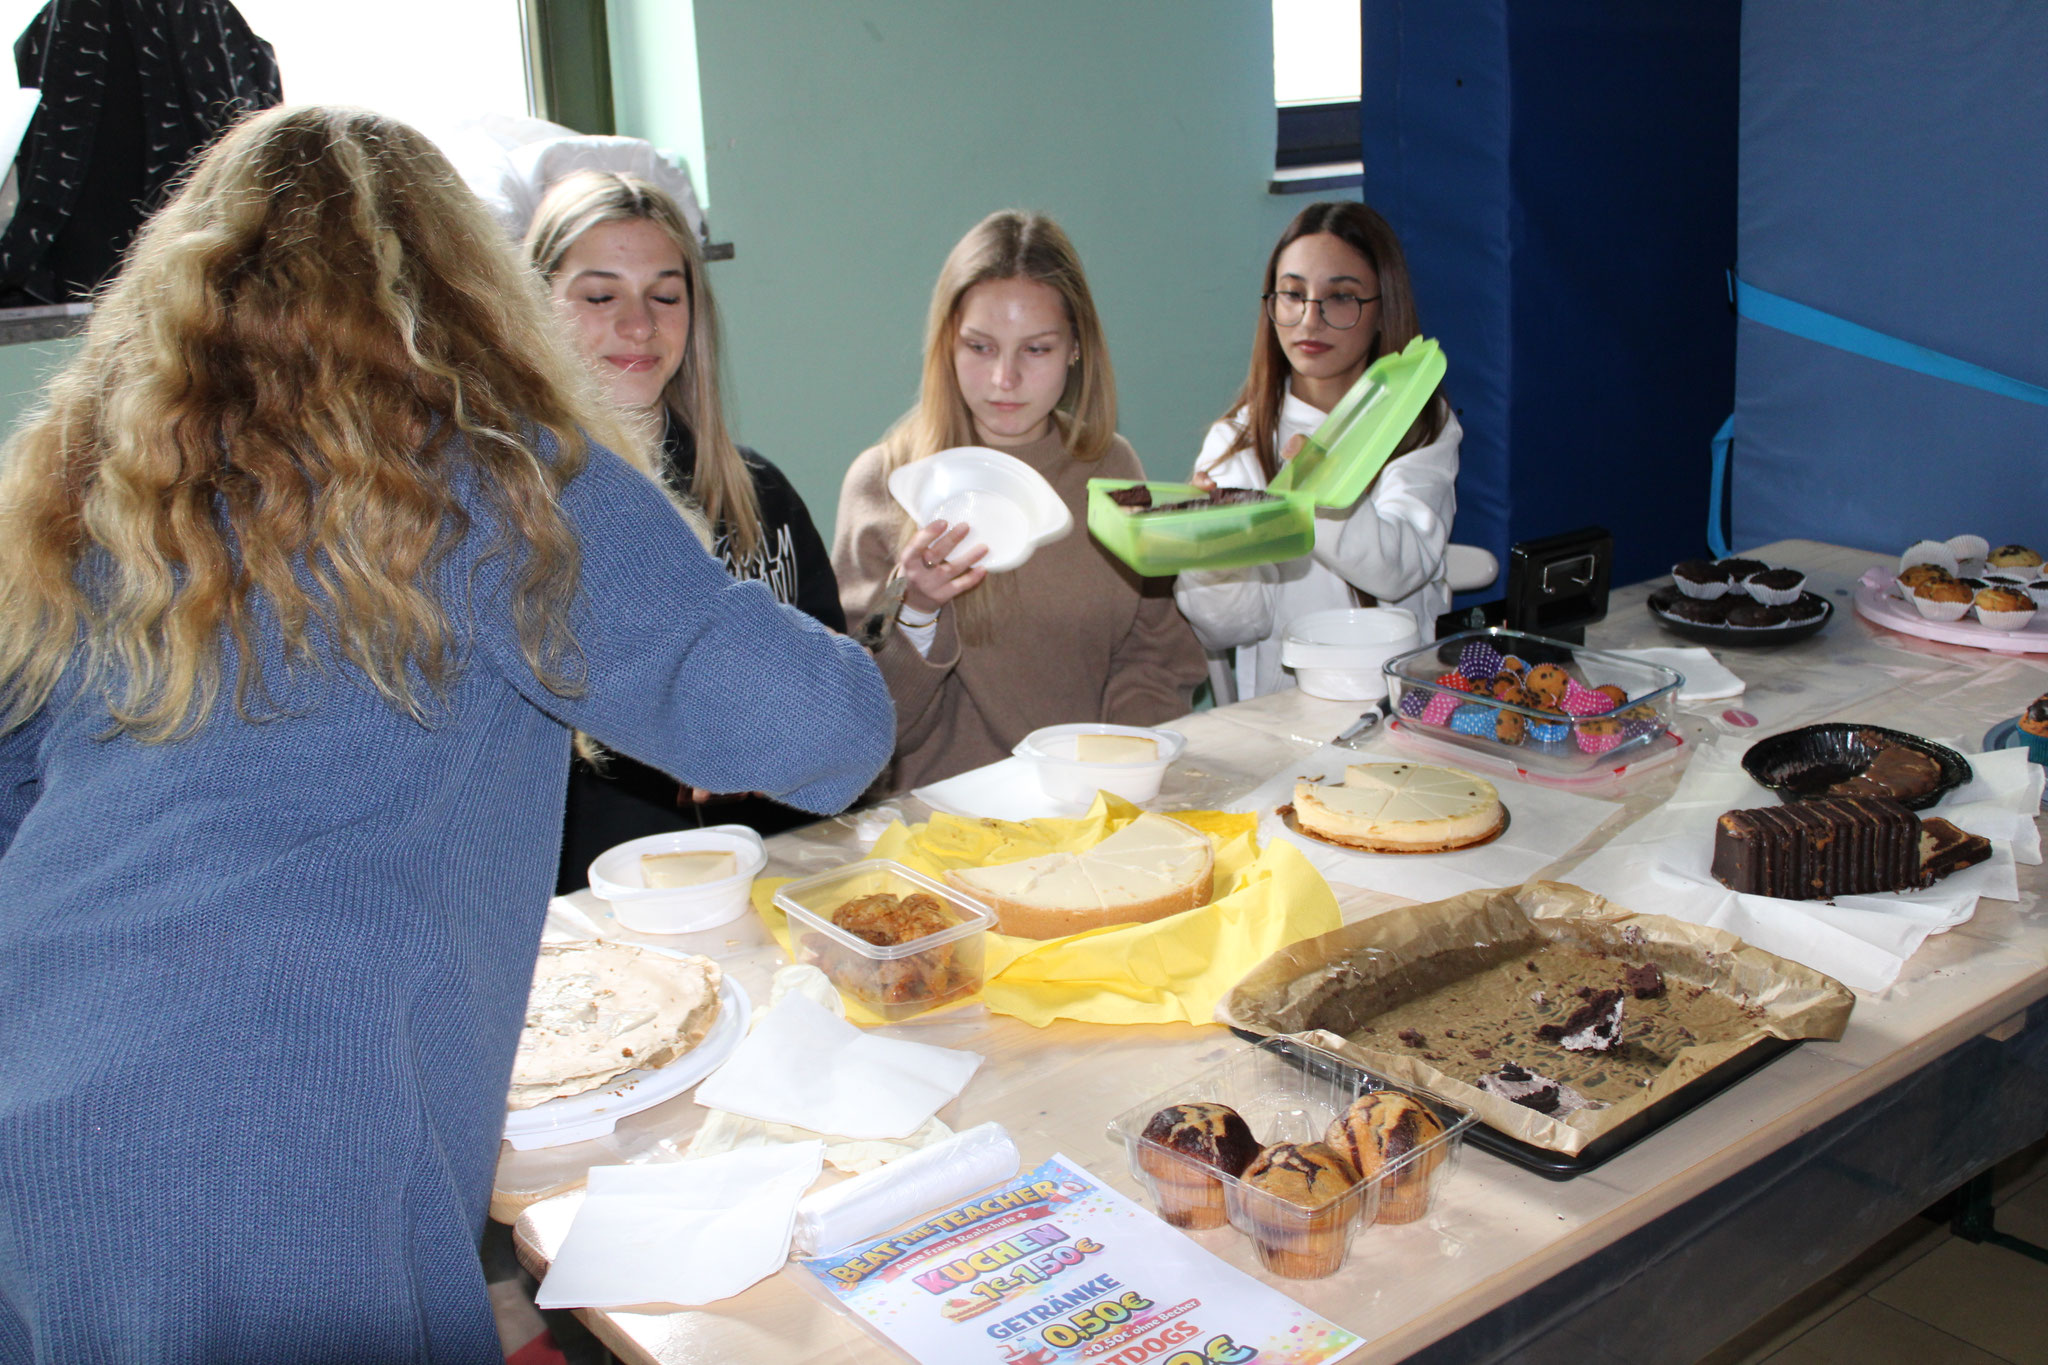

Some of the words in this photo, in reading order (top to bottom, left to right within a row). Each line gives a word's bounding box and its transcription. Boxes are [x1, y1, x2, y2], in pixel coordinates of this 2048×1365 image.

[827, 1240, 907, 1285] BEAT
[892, 1224, 942, 1246] THE
[927, 1180, 1060, 1233] TEACHER
[895, 1255, 926, 1271] Anne
[924, 1240, 958, 1257] Frank
[956, 1215, 1017, 1243] Realschule
[911, 1223, 1071, 1296] KUCHEN
[986, 1273, 1121, 1339] GETRÄNKE
[1041, 1290, 1155, 1349] 0,50€
[1132, 1318, 1161, 1335] ohne
[1158, 1299, 1198, 1323] Becher
[1094, 1320, 1200, 1365] TDOGS
